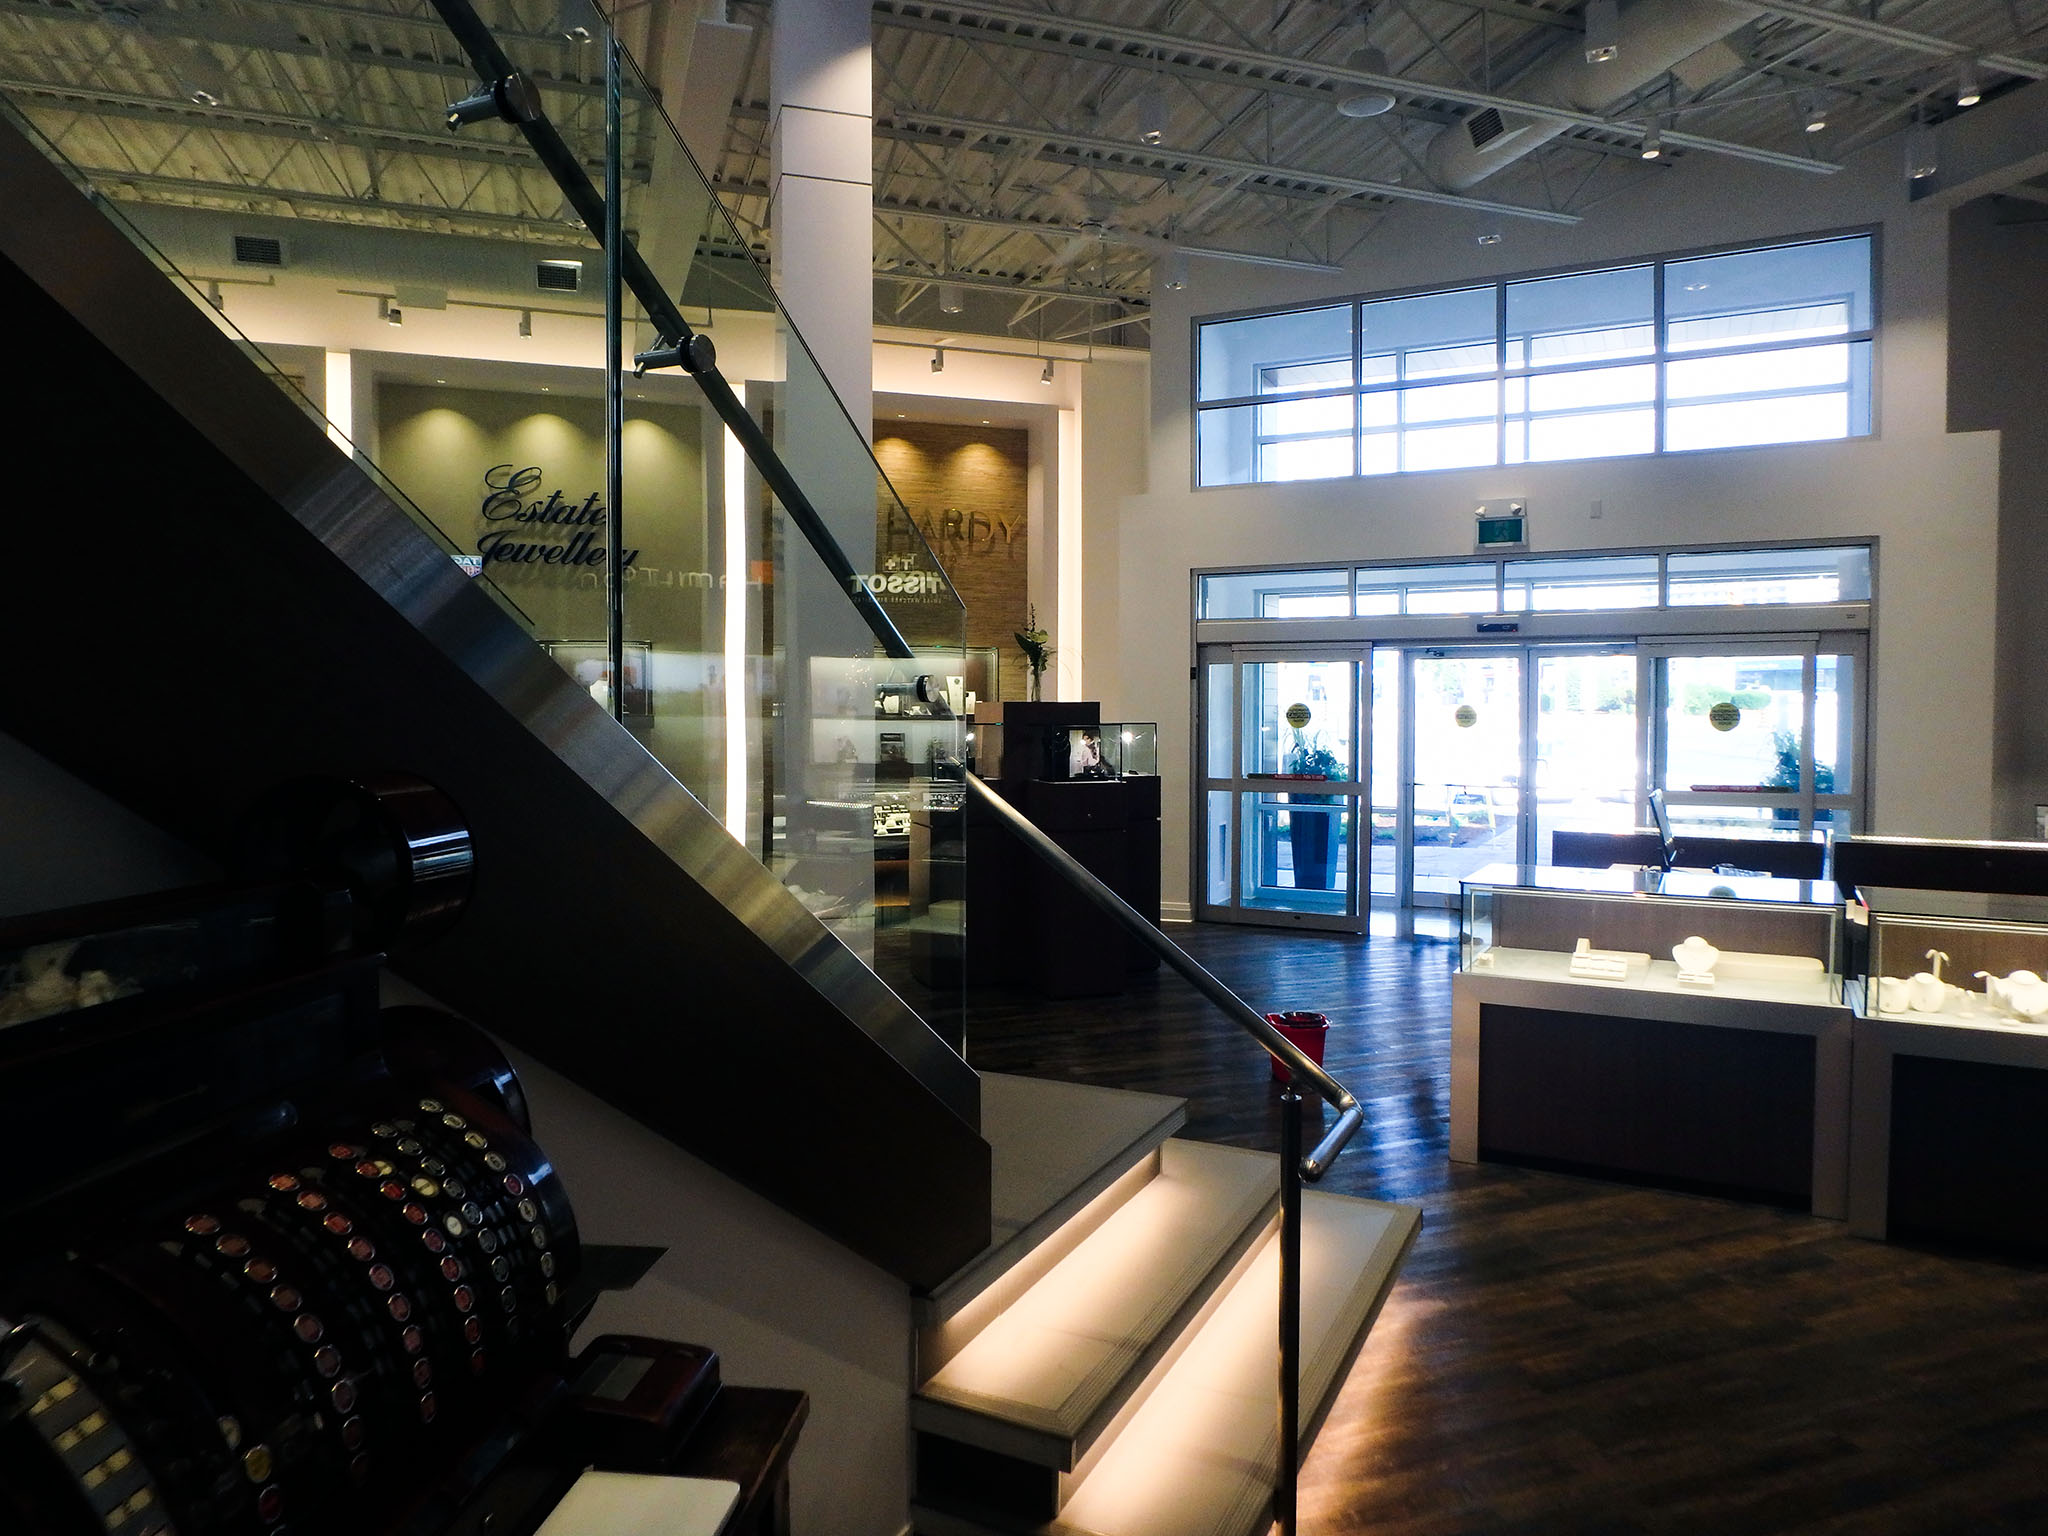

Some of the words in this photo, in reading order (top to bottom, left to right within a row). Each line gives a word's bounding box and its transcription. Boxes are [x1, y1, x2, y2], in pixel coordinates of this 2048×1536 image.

[482, 464, 606, 526] Estate
[887, 503, 1022, 545] HARDY
[477, 530, 640, 570] Jewelley
